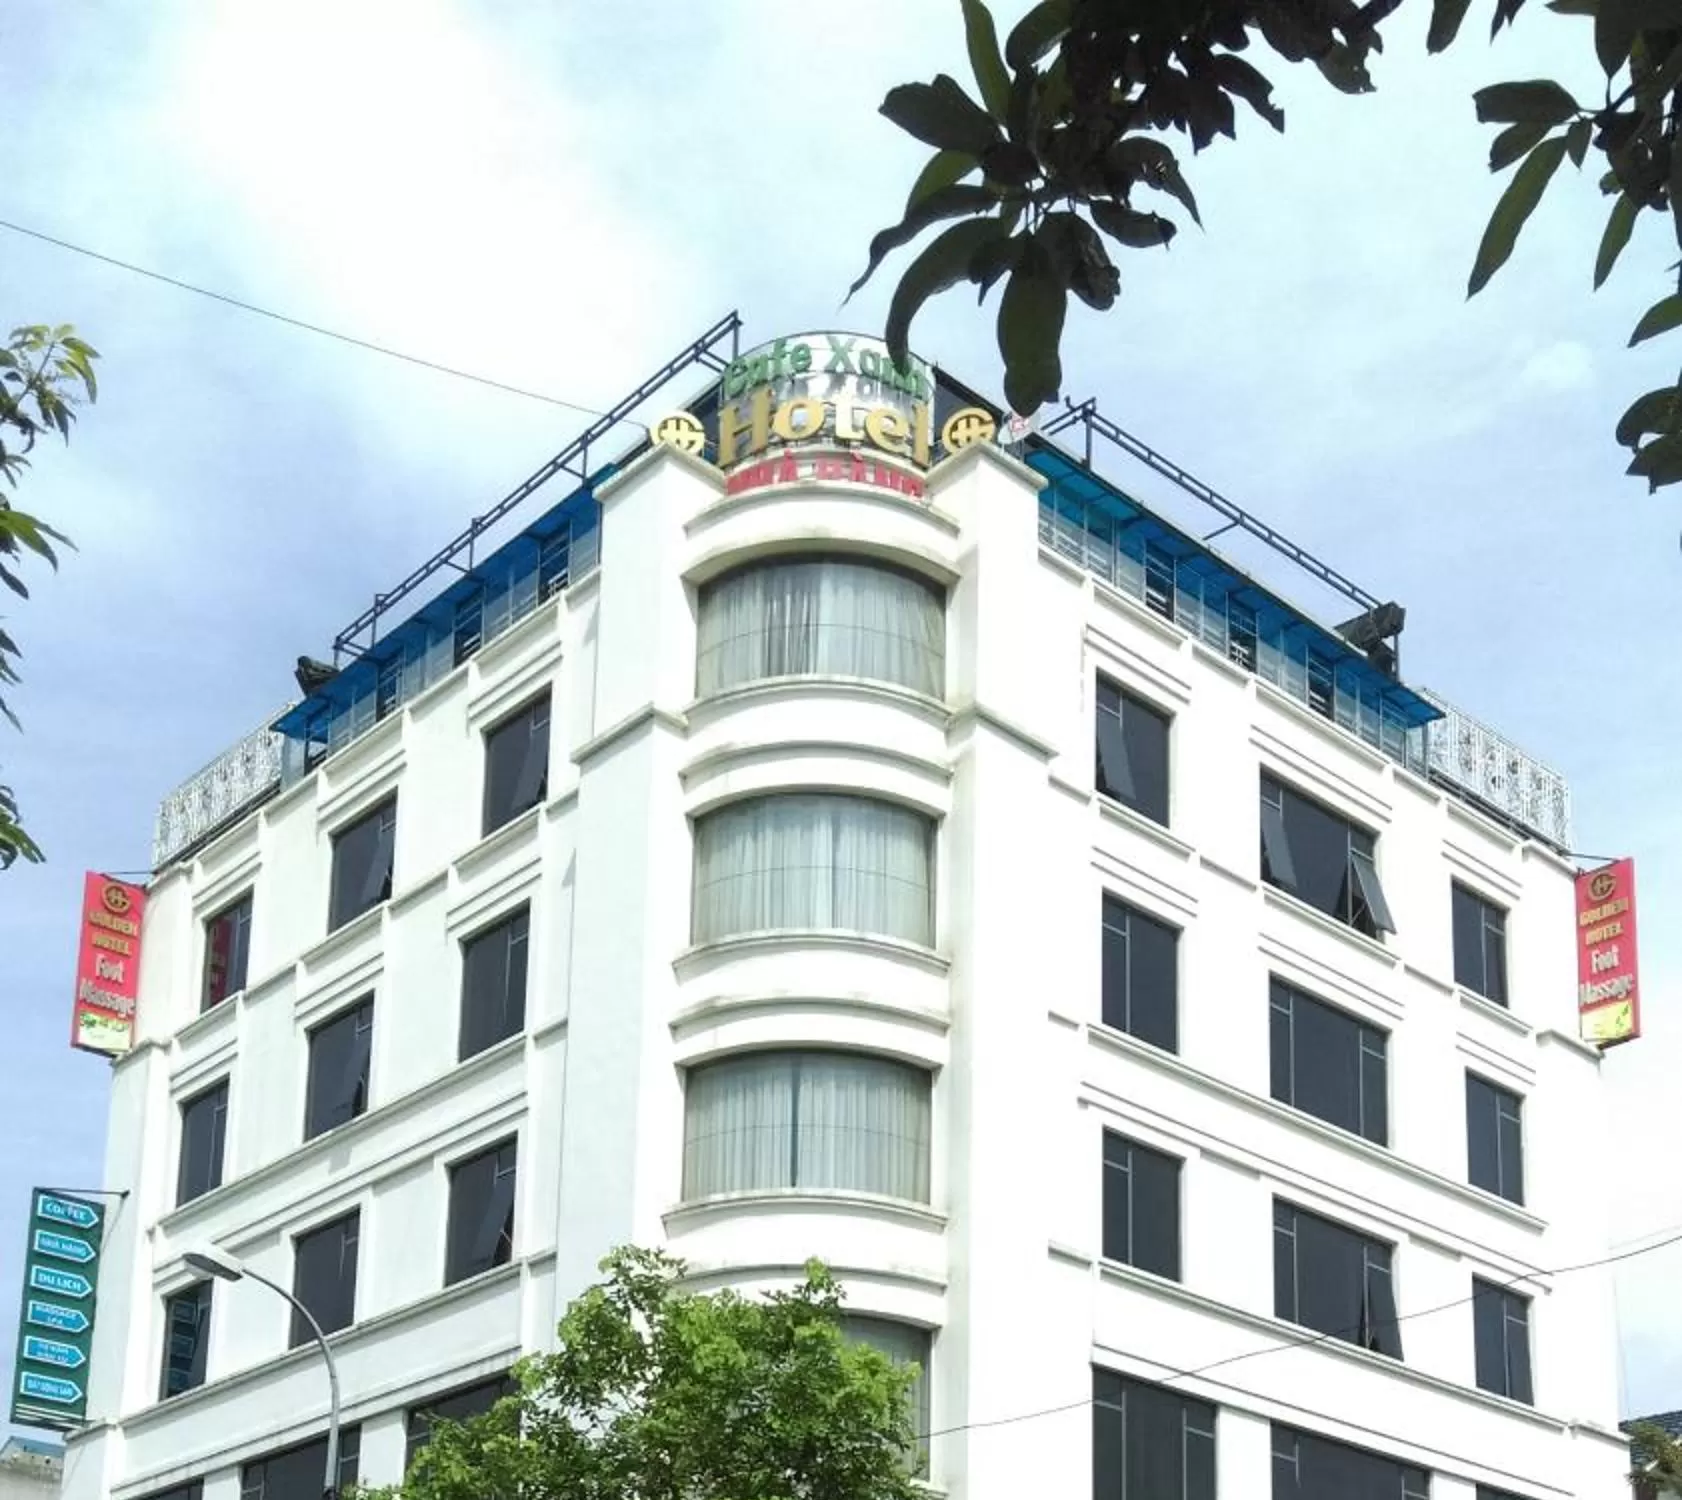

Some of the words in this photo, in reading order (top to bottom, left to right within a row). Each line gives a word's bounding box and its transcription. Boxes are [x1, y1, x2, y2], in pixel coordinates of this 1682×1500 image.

[724, 337, 812, 396] Cafe
[718, 388, 930, 469] Hotel
[96, 953, 124, 983] Foot
[1591, 944, 1620, 974] Foot
[80, 978, 136, 1018] Massage
[1580, 974, 1634, 1007] Massage
